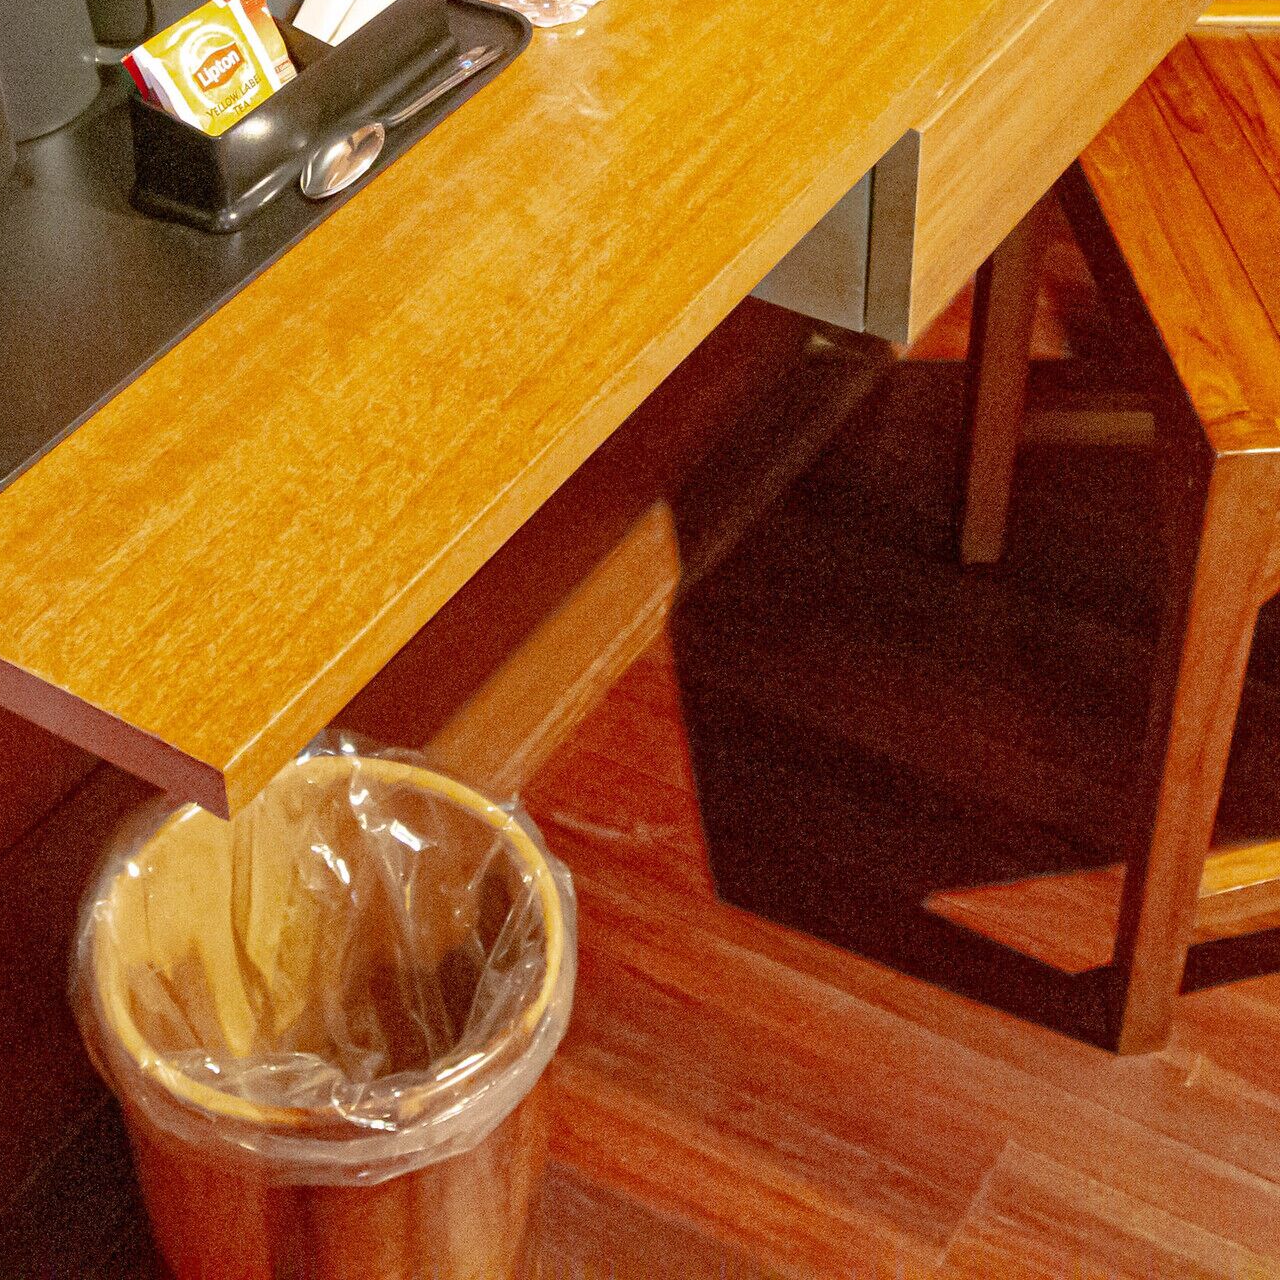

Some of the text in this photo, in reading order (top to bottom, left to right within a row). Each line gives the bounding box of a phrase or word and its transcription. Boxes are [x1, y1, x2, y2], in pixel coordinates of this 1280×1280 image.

[197, 50, 241, 88] Lipton
[206, 90, 240, 121] YELLOW
[232, 99, 252, 116] TEA
